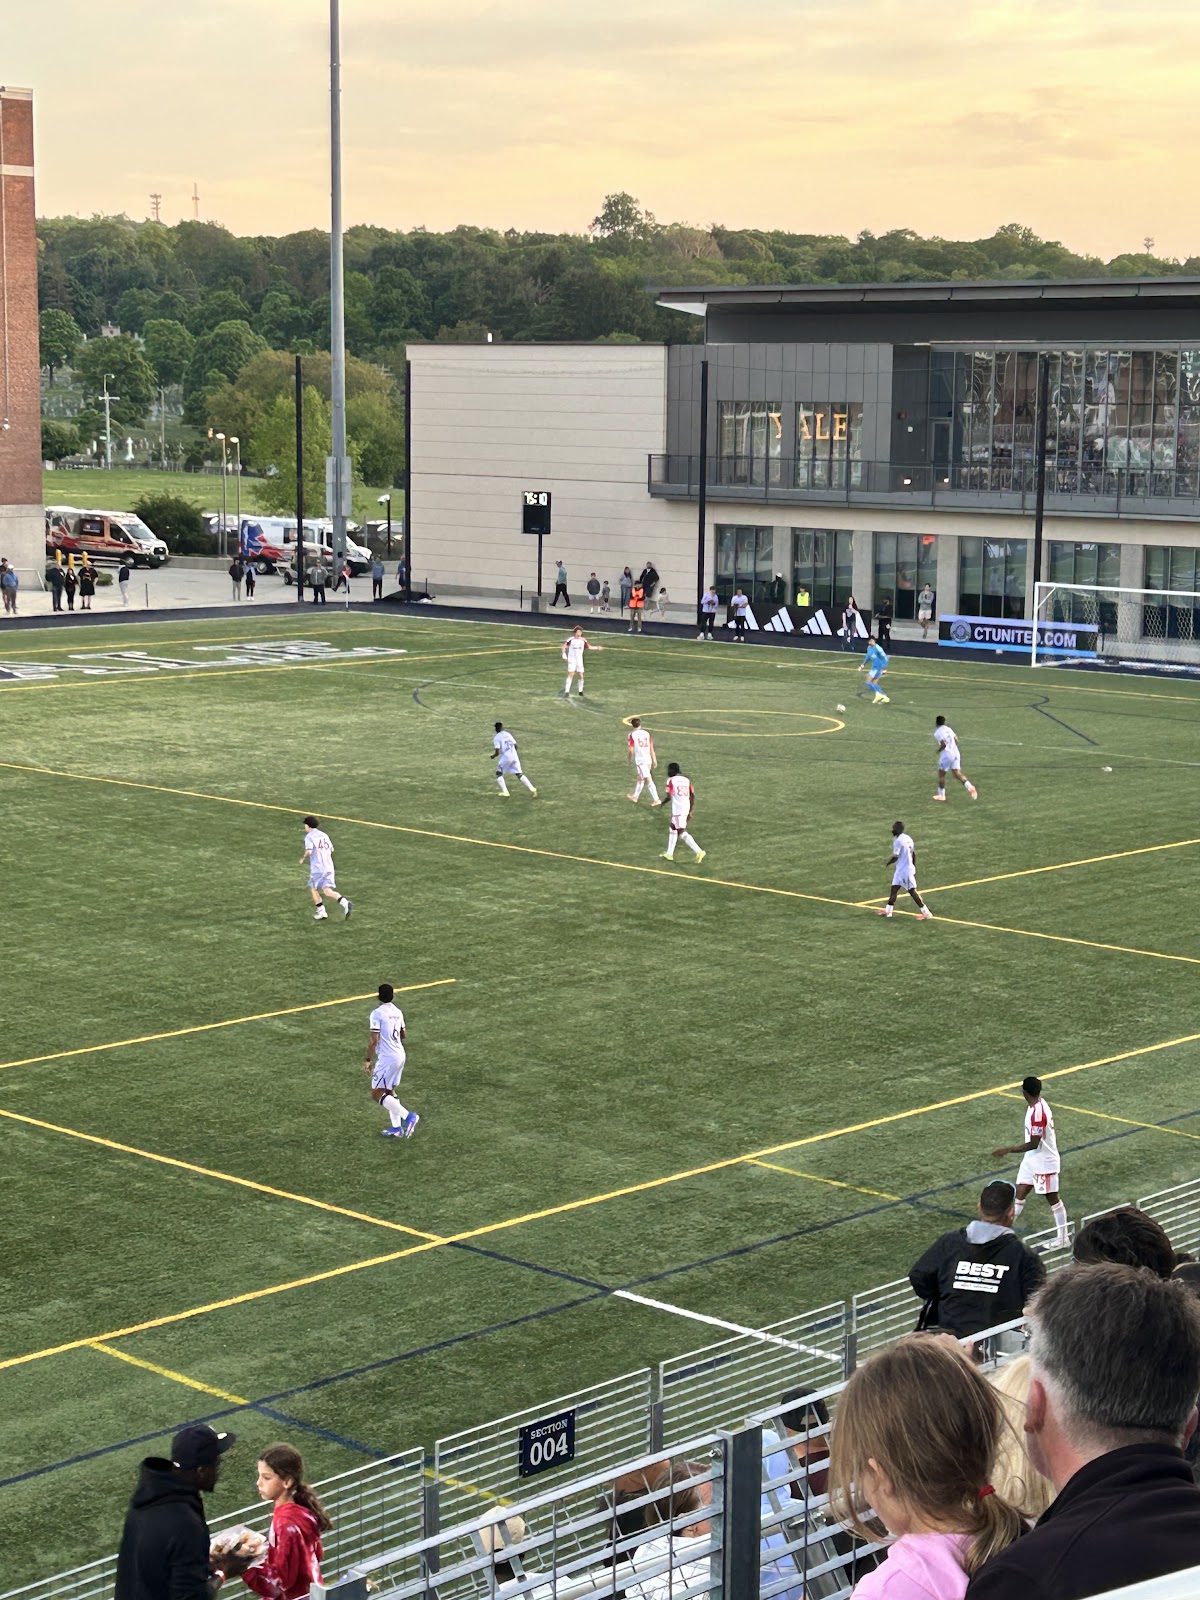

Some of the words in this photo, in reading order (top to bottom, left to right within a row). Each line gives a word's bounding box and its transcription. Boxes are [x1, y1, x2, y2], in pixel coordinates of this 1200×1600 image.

[973, 626, 1077, 648] CTUNITED.COM
[955, 1260, 1010, 1279] BEST
[530, 1418, 568, 1440] SECTION
[530, 1432, 568, 1466] 004
